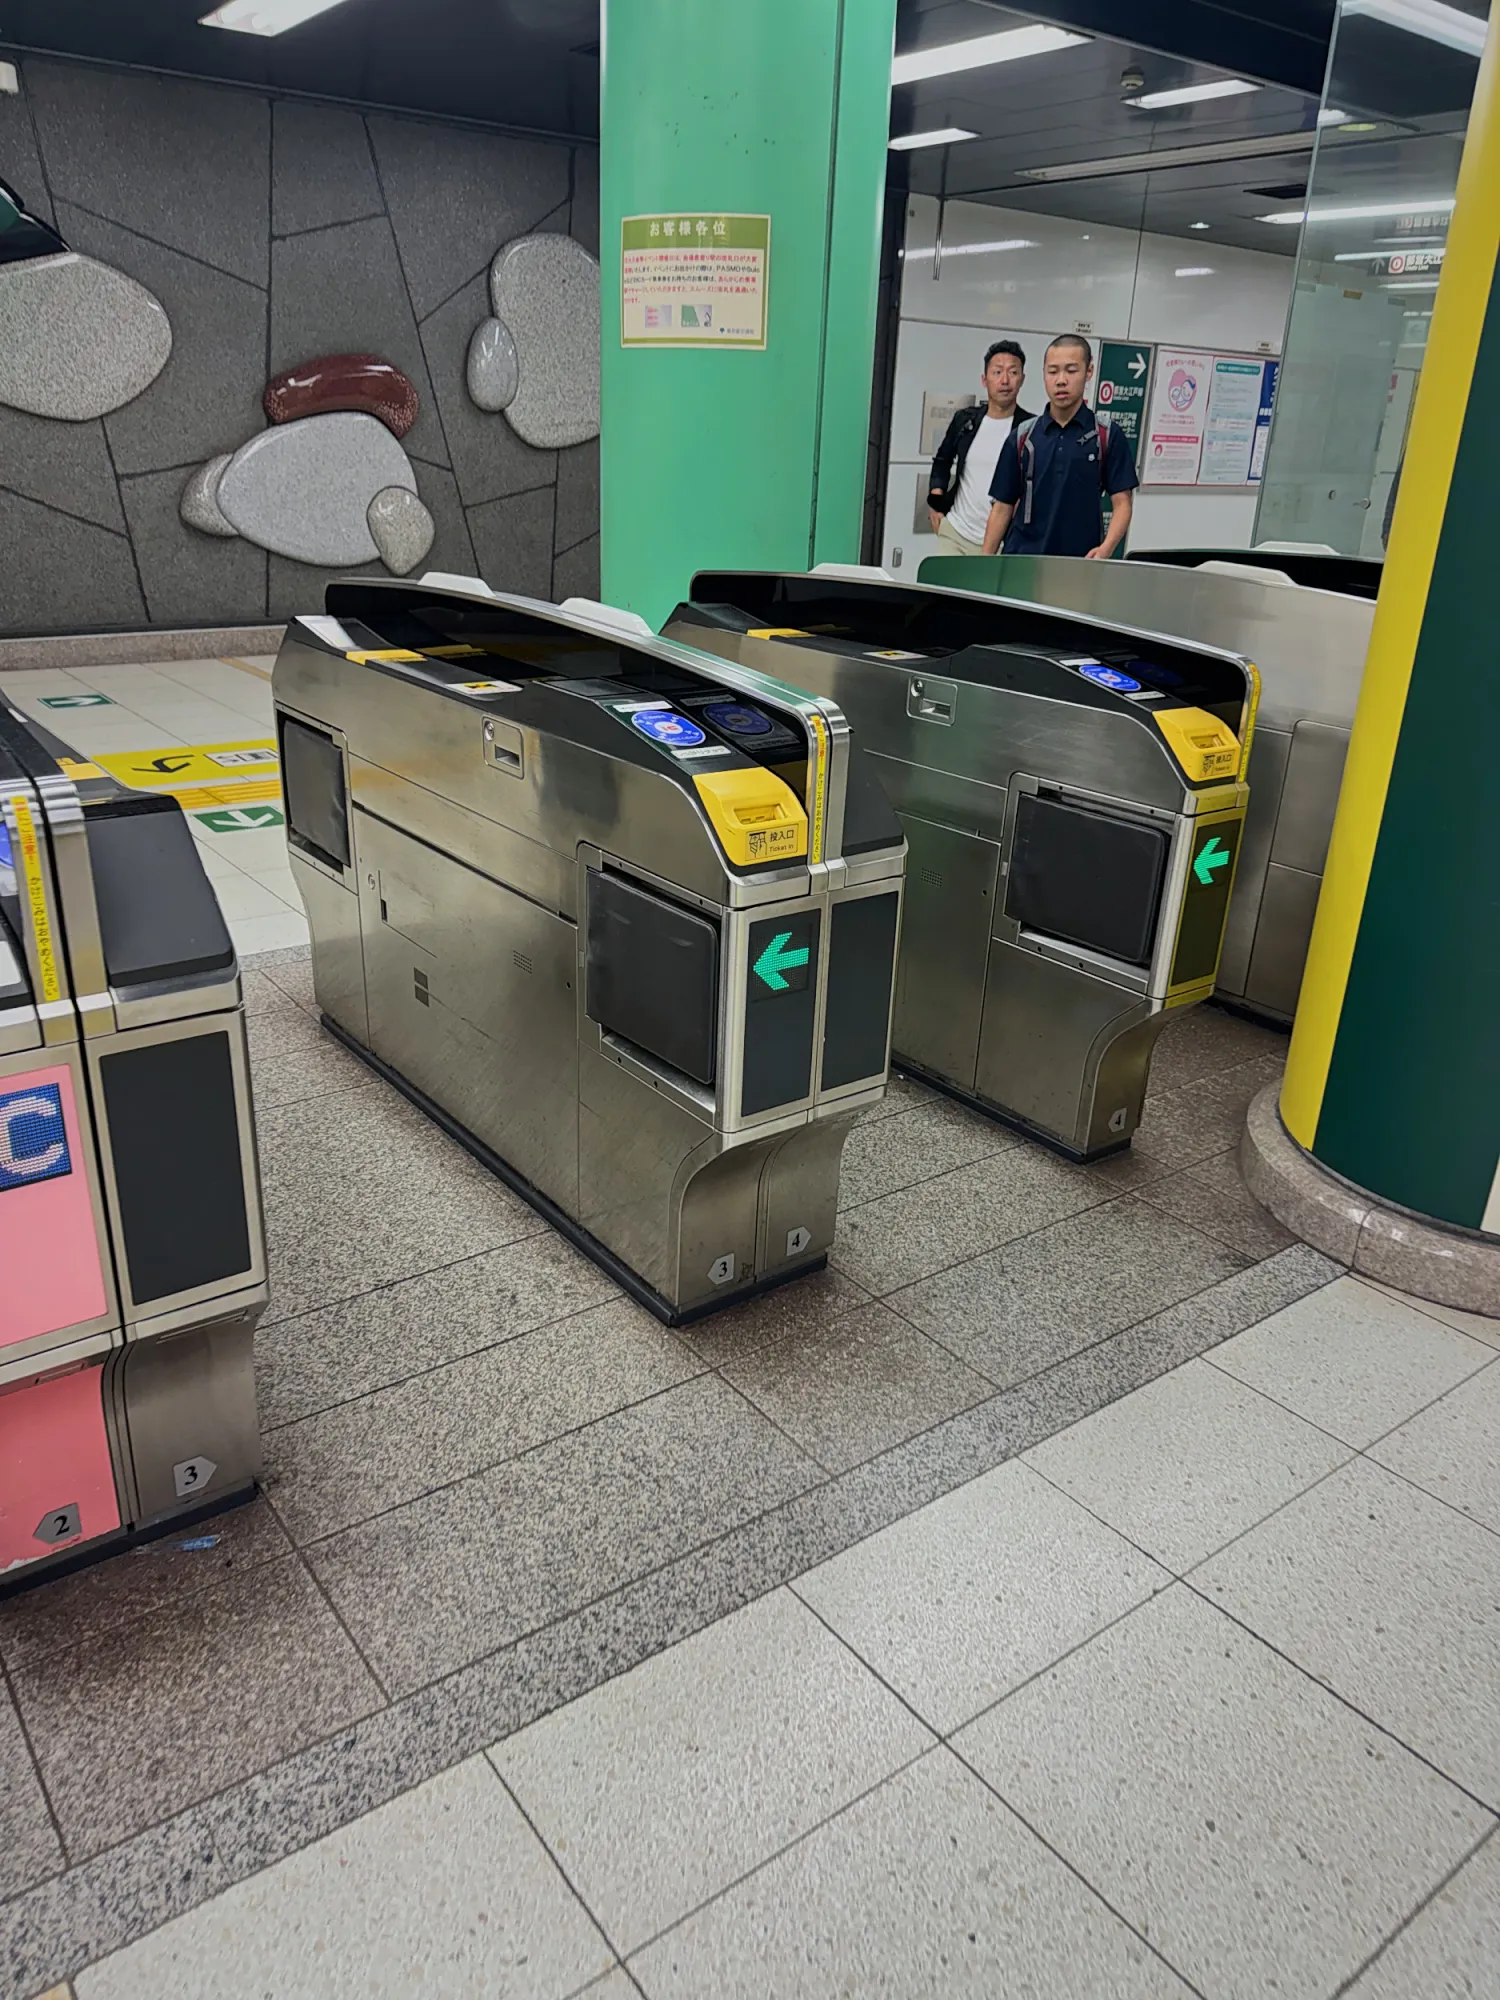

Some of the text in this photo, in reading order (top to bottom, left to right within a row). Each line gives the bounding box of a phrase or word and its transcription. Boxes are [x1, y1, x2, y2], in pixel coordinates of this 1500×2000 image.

[650, 219, 726, 237] お客様各位
[769, 829, 794, 842] 投入口
[791, 1232, 801, 1247] 4
[718, 1261, 728, 1278] 3
[184, 1465, 198, 1486] 3
[53, 1514, 71, 1537] 2
